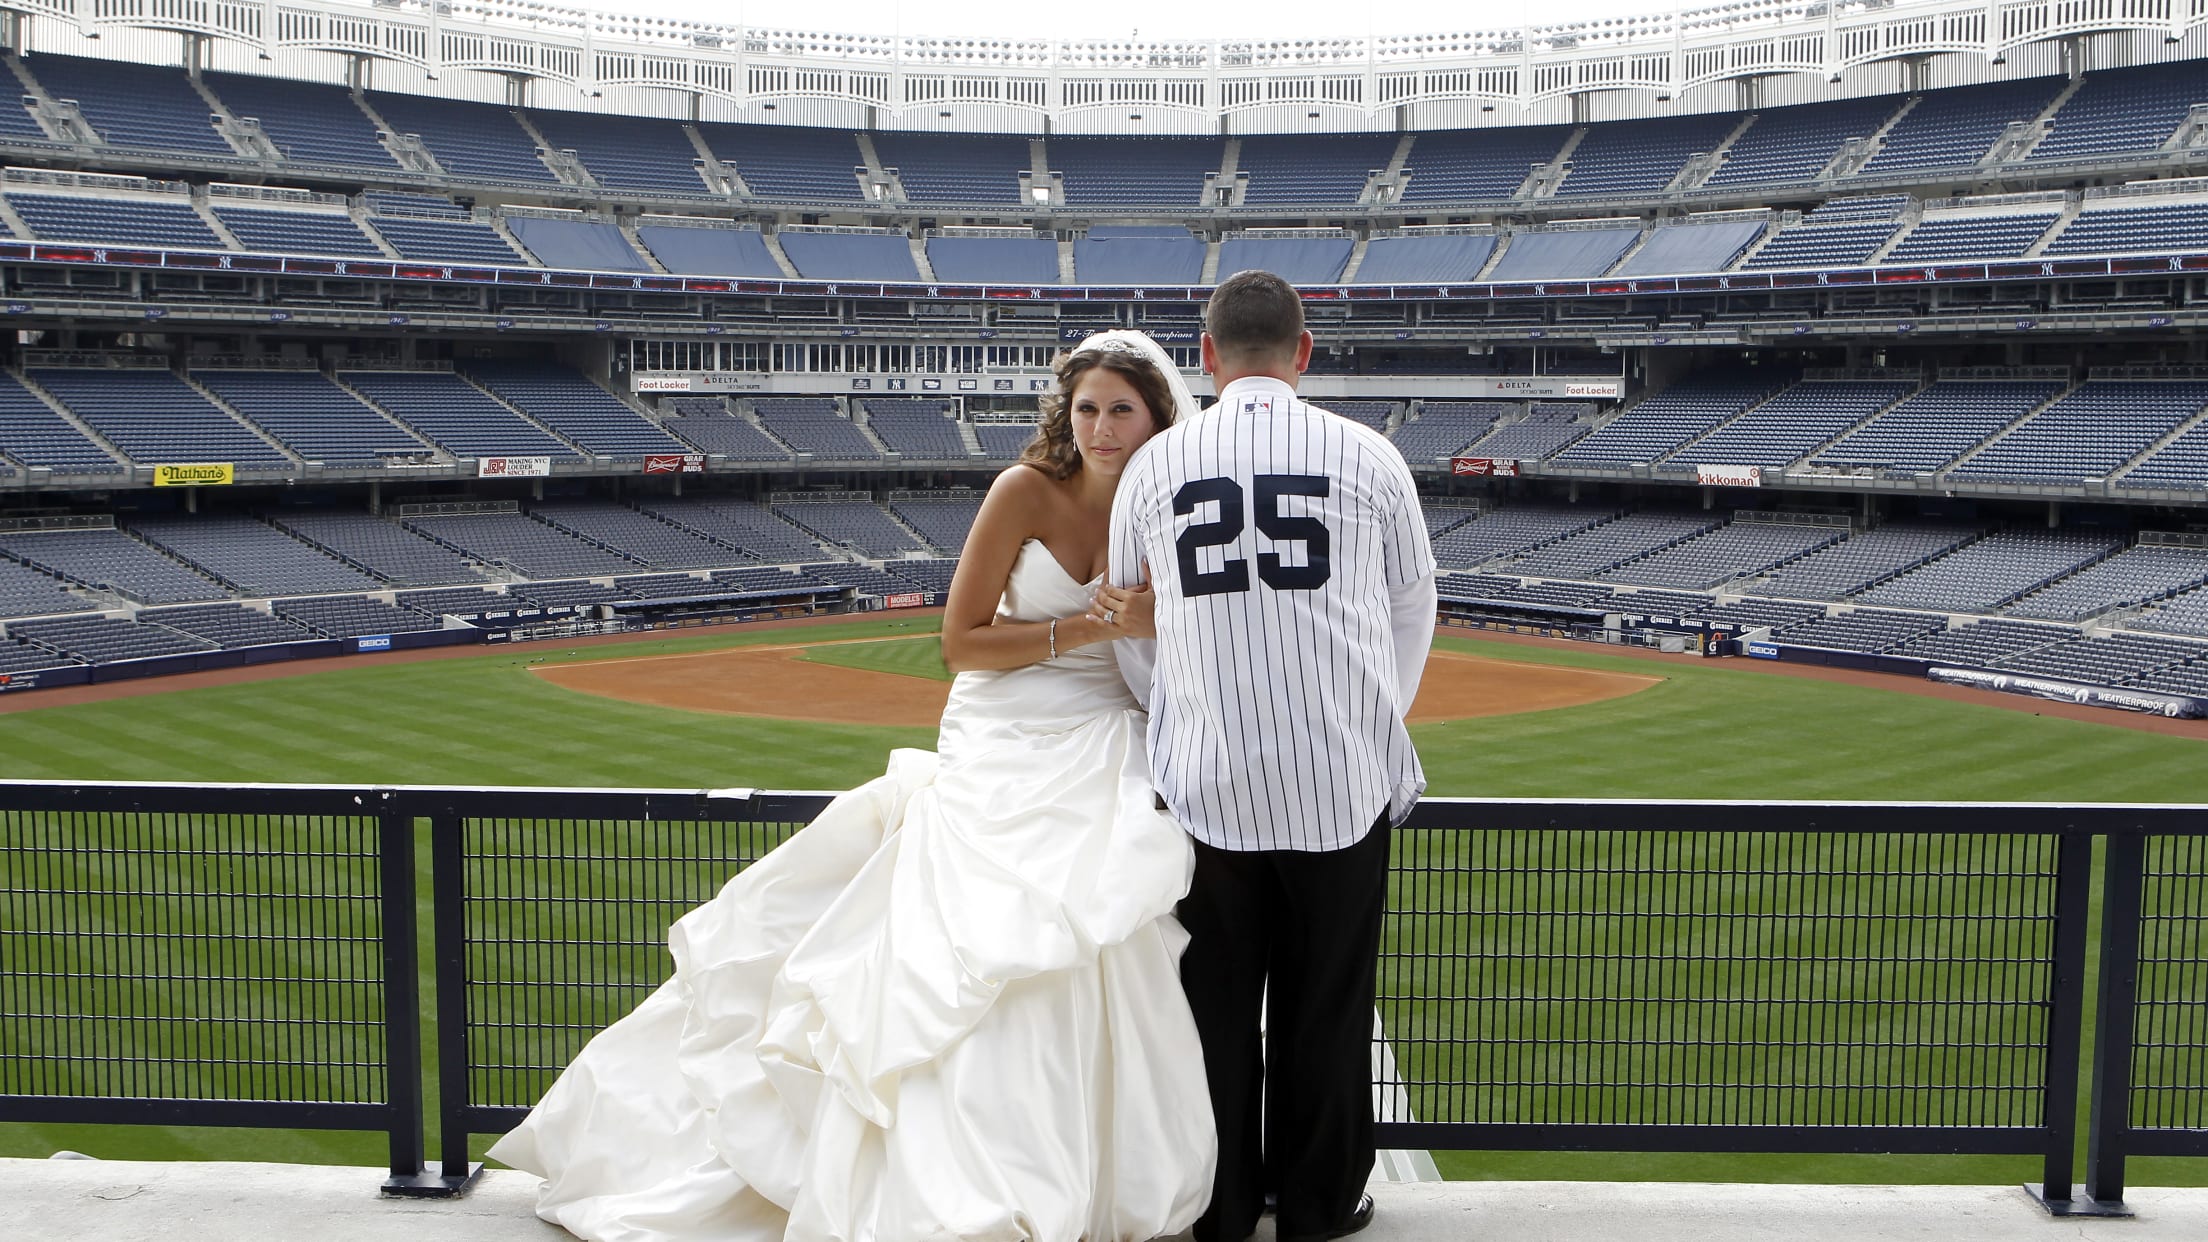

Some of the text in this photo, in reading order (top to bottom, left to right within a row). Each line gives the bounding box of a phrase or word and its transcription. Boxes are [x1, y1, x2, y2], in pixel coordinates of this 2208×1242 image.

[639, 380, 689, 389] Foot Locker
[1566, 386, 1616, 395] Foot Locker
[163, 466, 224, 480] Nathan's
[682, 465, 703, 473] BUDS
[1697, 473, 1754, 487] kikkoman
[1173, 474, 1331, 598] 25
[891, 595, 920, 604] MODELL'S
[1621, 613, 1627, 621] G
[1650, 616, 1656, 624] G
[1679, 619, 1685, 627] G
[1709, 622, 1715, 630] G
[1740, 624, 1746, 633] G
[359, 639, 390, 648] GEICO
[1749, 645, 1777, 656] GEICO
[1938, 668, 1995, 682] WEATHERPROOF
[2013, 678, 2076, 696] WEATHERPROOF
[2097, 691, 2166, 711] WEATHERPROOF
